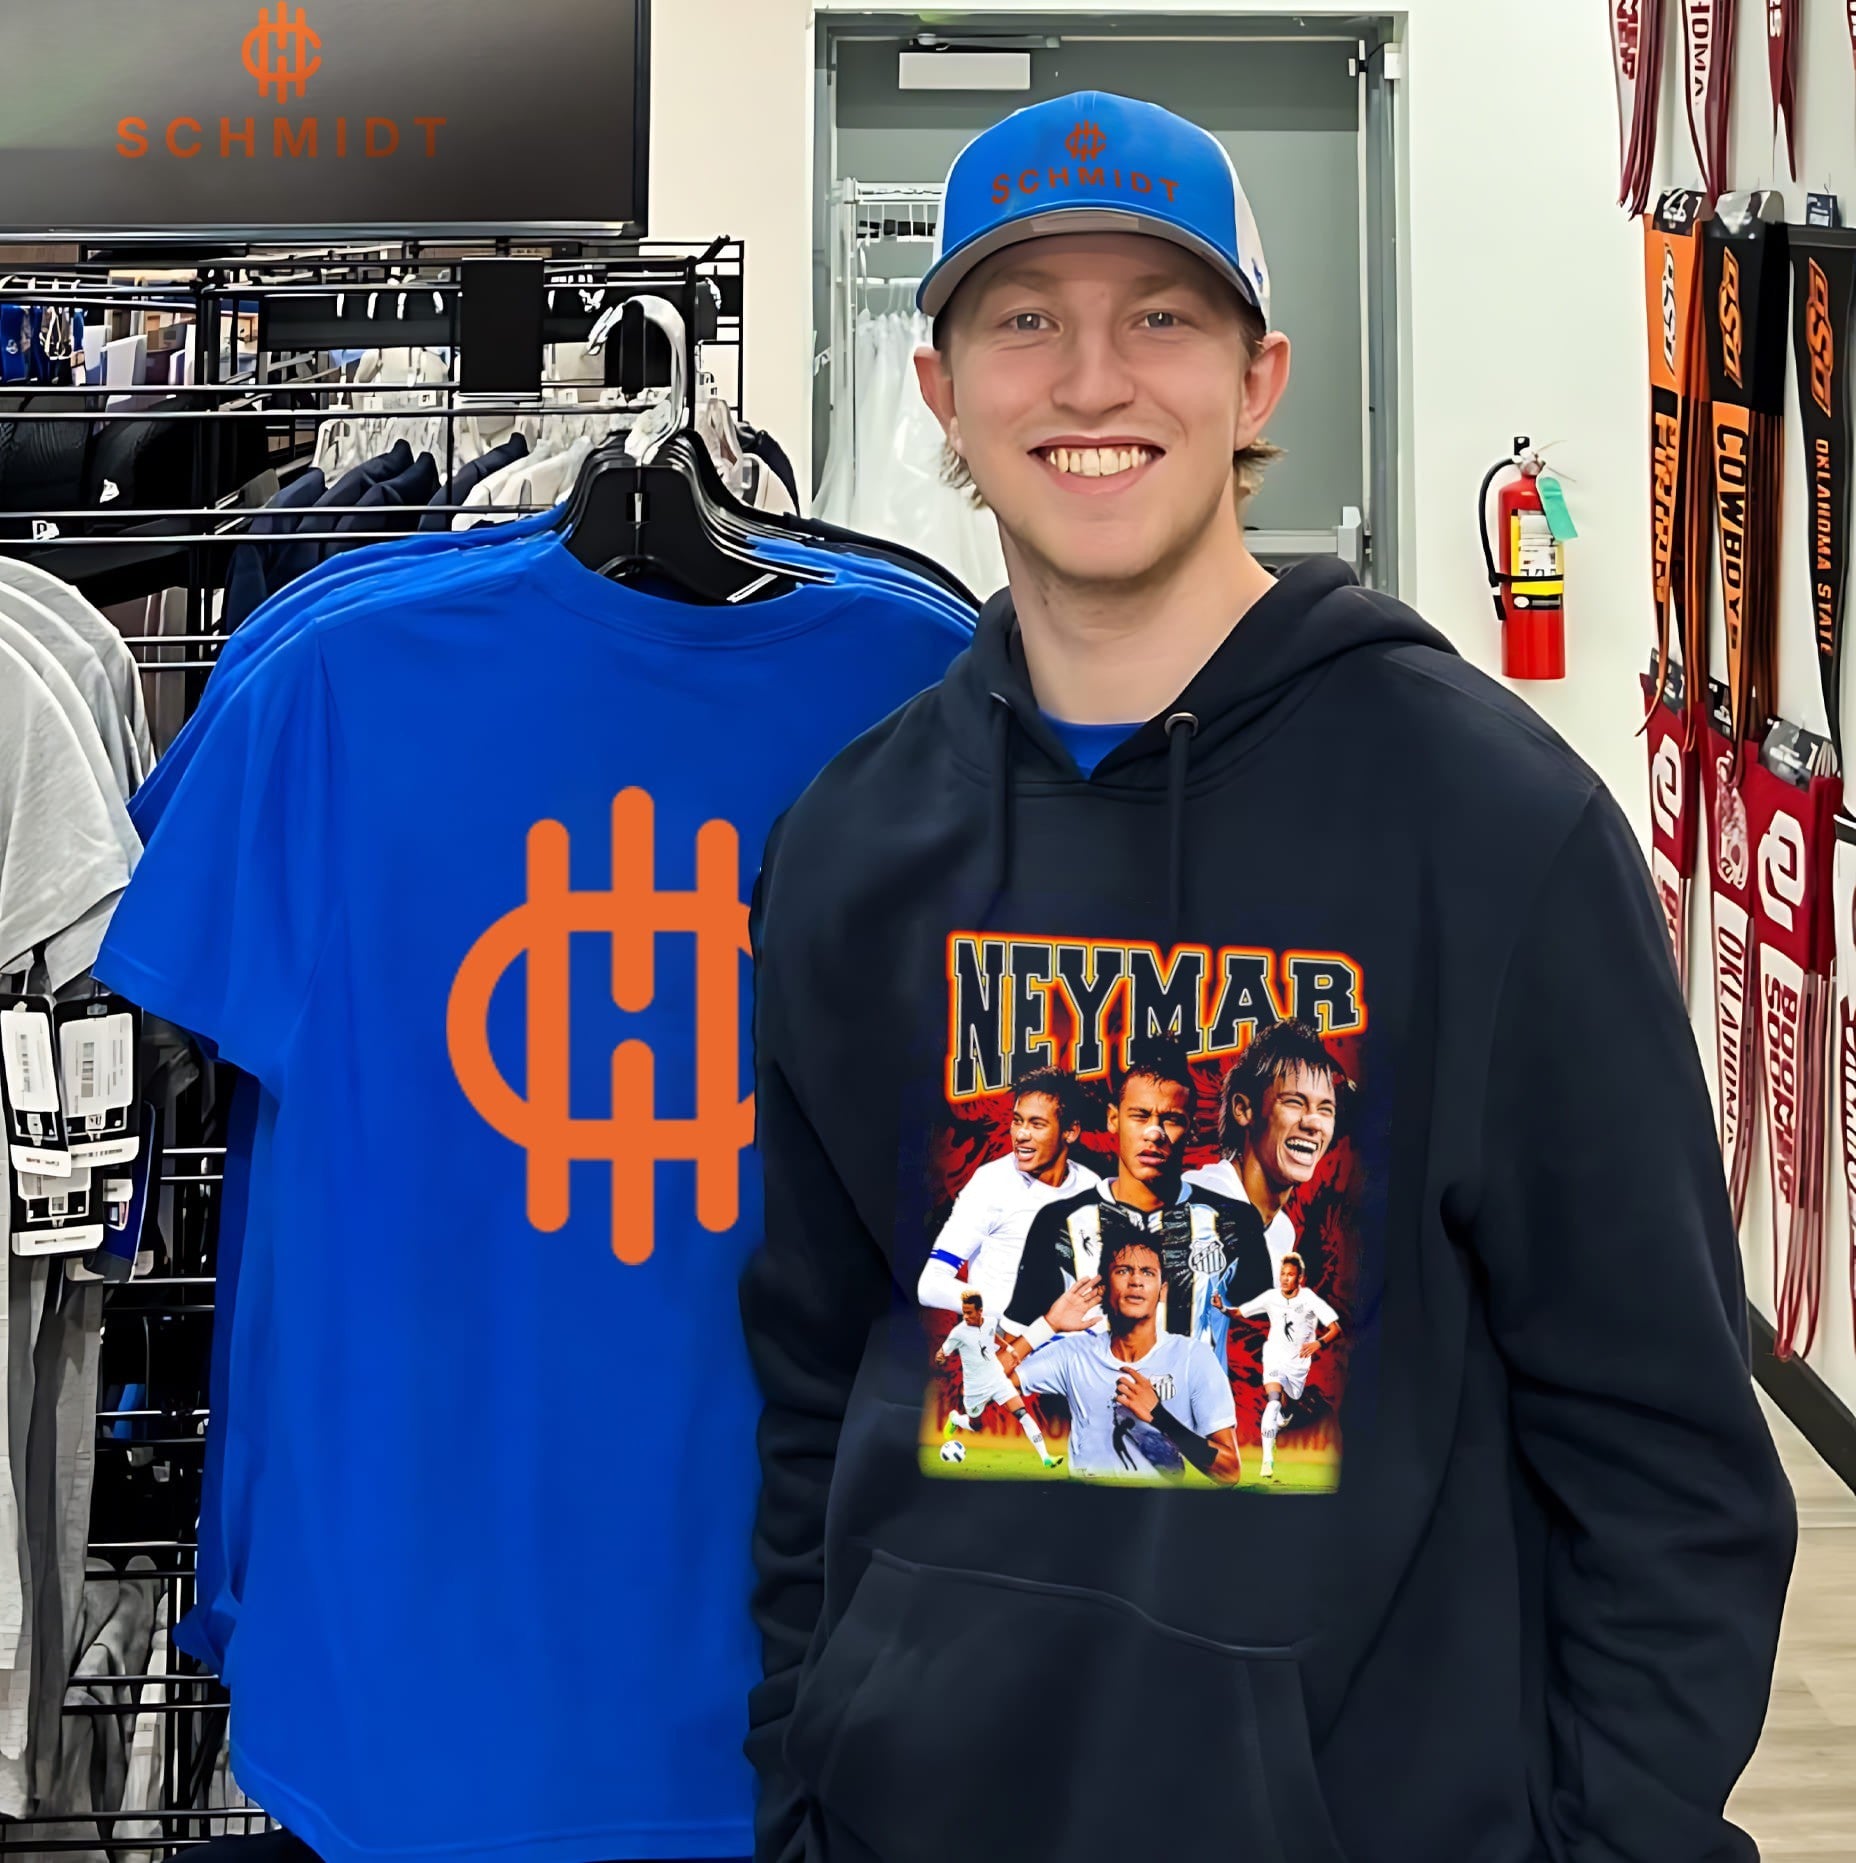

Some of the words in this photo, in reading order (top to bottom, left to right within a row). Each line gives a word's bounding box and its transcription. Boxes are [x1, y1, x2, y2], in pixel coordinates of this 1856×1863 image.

[116, 116, 448, 159] SCHMIDT
[991, 166, 1180, 205] SCHMIDT
[1815, 438, 1833, 571] OKLAHOMA
[950, 935, 1364, 1098] NEYMAR
